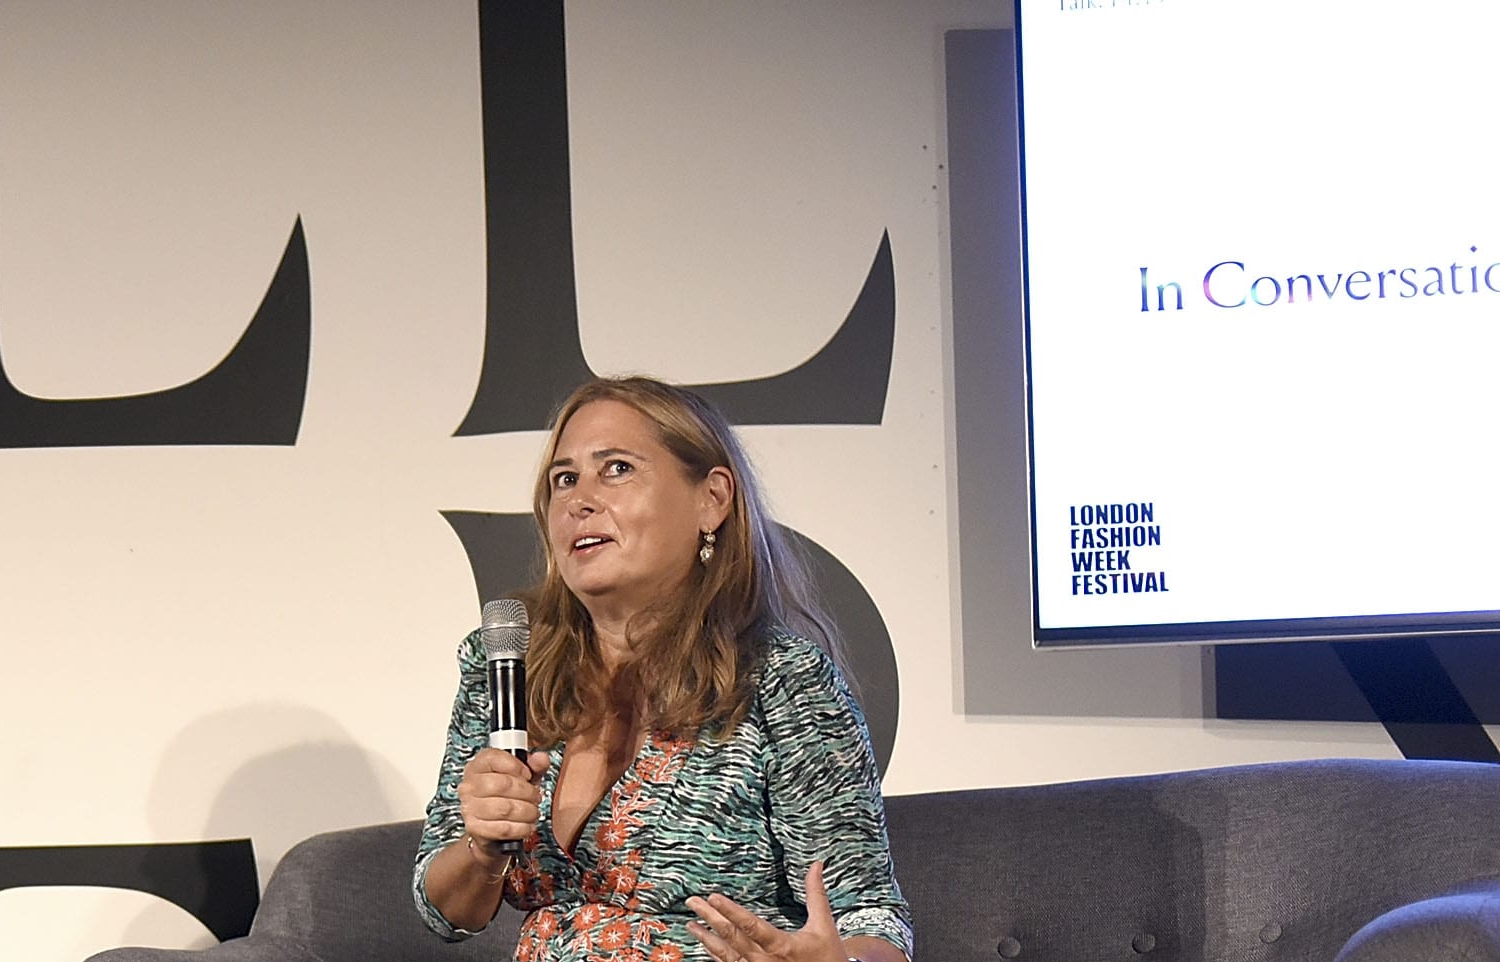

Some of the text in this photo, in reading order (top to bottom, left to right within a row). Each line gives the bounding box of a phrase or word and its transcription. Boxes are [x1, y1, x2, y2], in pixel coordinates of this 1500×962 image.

[1139, 266, 1184, 312] In
[1070, 502, 1153, 526] LONDON
[1071, 525, 1161, 549] FASHION
[1071, 549, 1131, 572] WEEK
[1072, 571, 1169, 595] FESTIVAL
